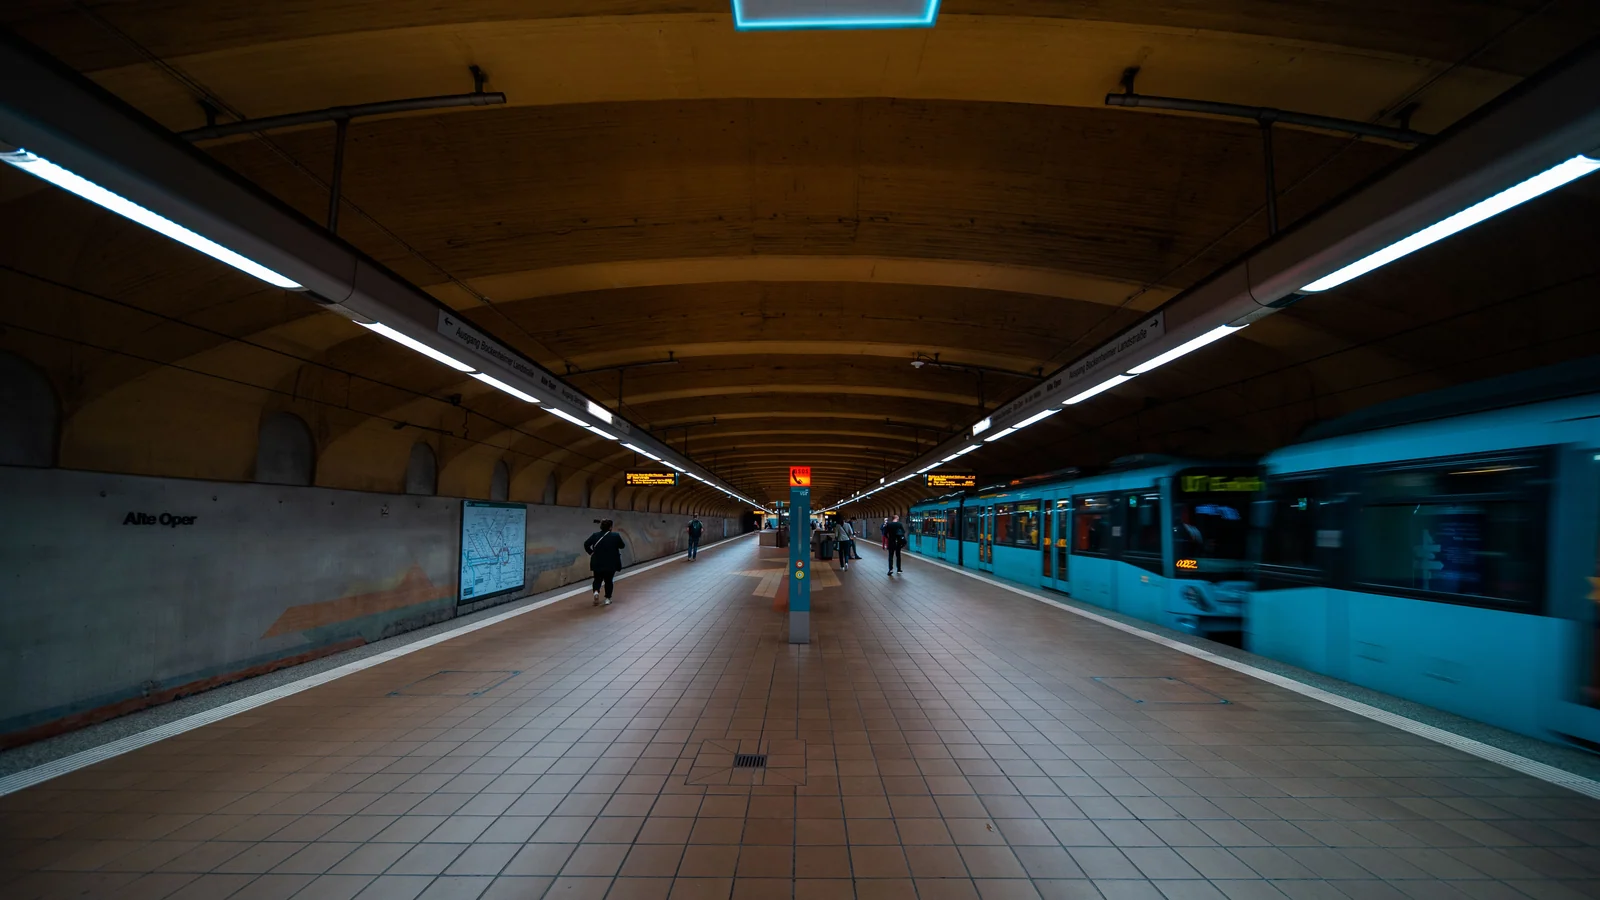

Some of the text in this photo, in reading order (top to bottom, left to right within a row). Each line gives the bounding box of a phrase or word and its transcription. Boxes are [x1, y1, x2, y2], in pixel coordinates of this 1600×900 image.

[456, 327, 481, 349] Ausgang
[481, 341, 513, 366] Bockenheimer
[1085, 347, 1117, 371] Bockenheimer
[1117, 329, 1147, 353] Landstraße
[123, 511, 198, 528] Alte Oper
